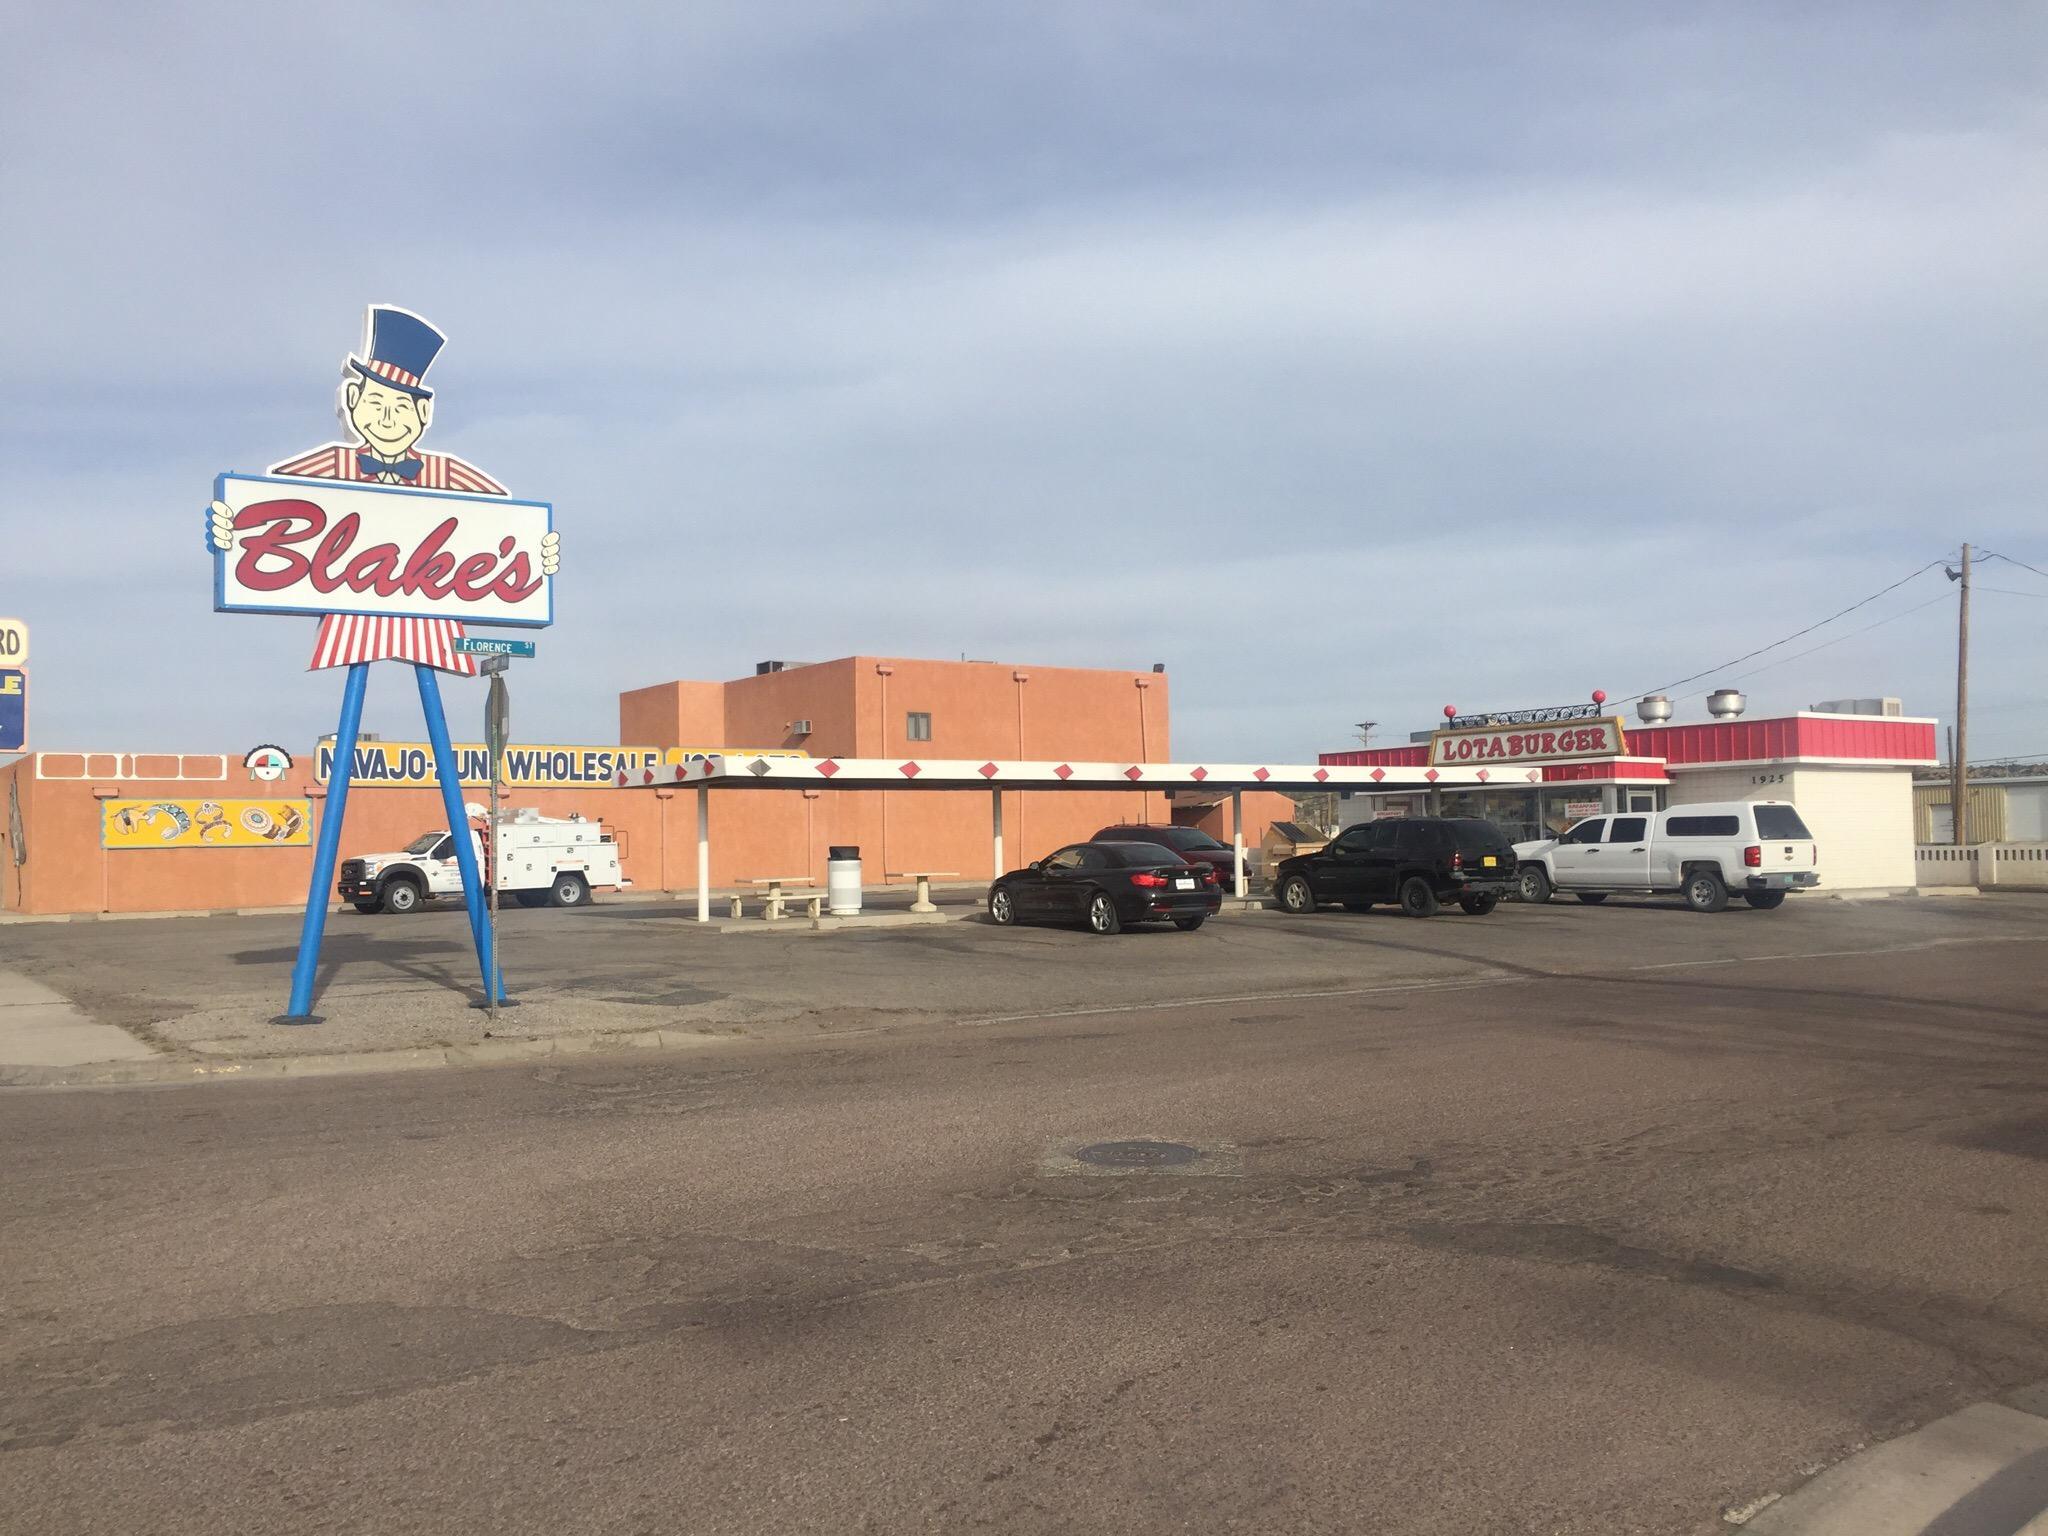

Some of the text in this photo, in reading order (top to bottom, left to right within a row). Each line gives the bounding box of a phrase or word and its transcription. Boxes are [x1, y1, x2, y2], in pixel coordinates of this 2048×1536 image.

[233, 498, 543, 603] Blake's
[463, 638, 513, 653] FLORENCE
[1443, 727, 1607, 760] LOTABURGER
[1751, 774, 1784, 785] 1925
